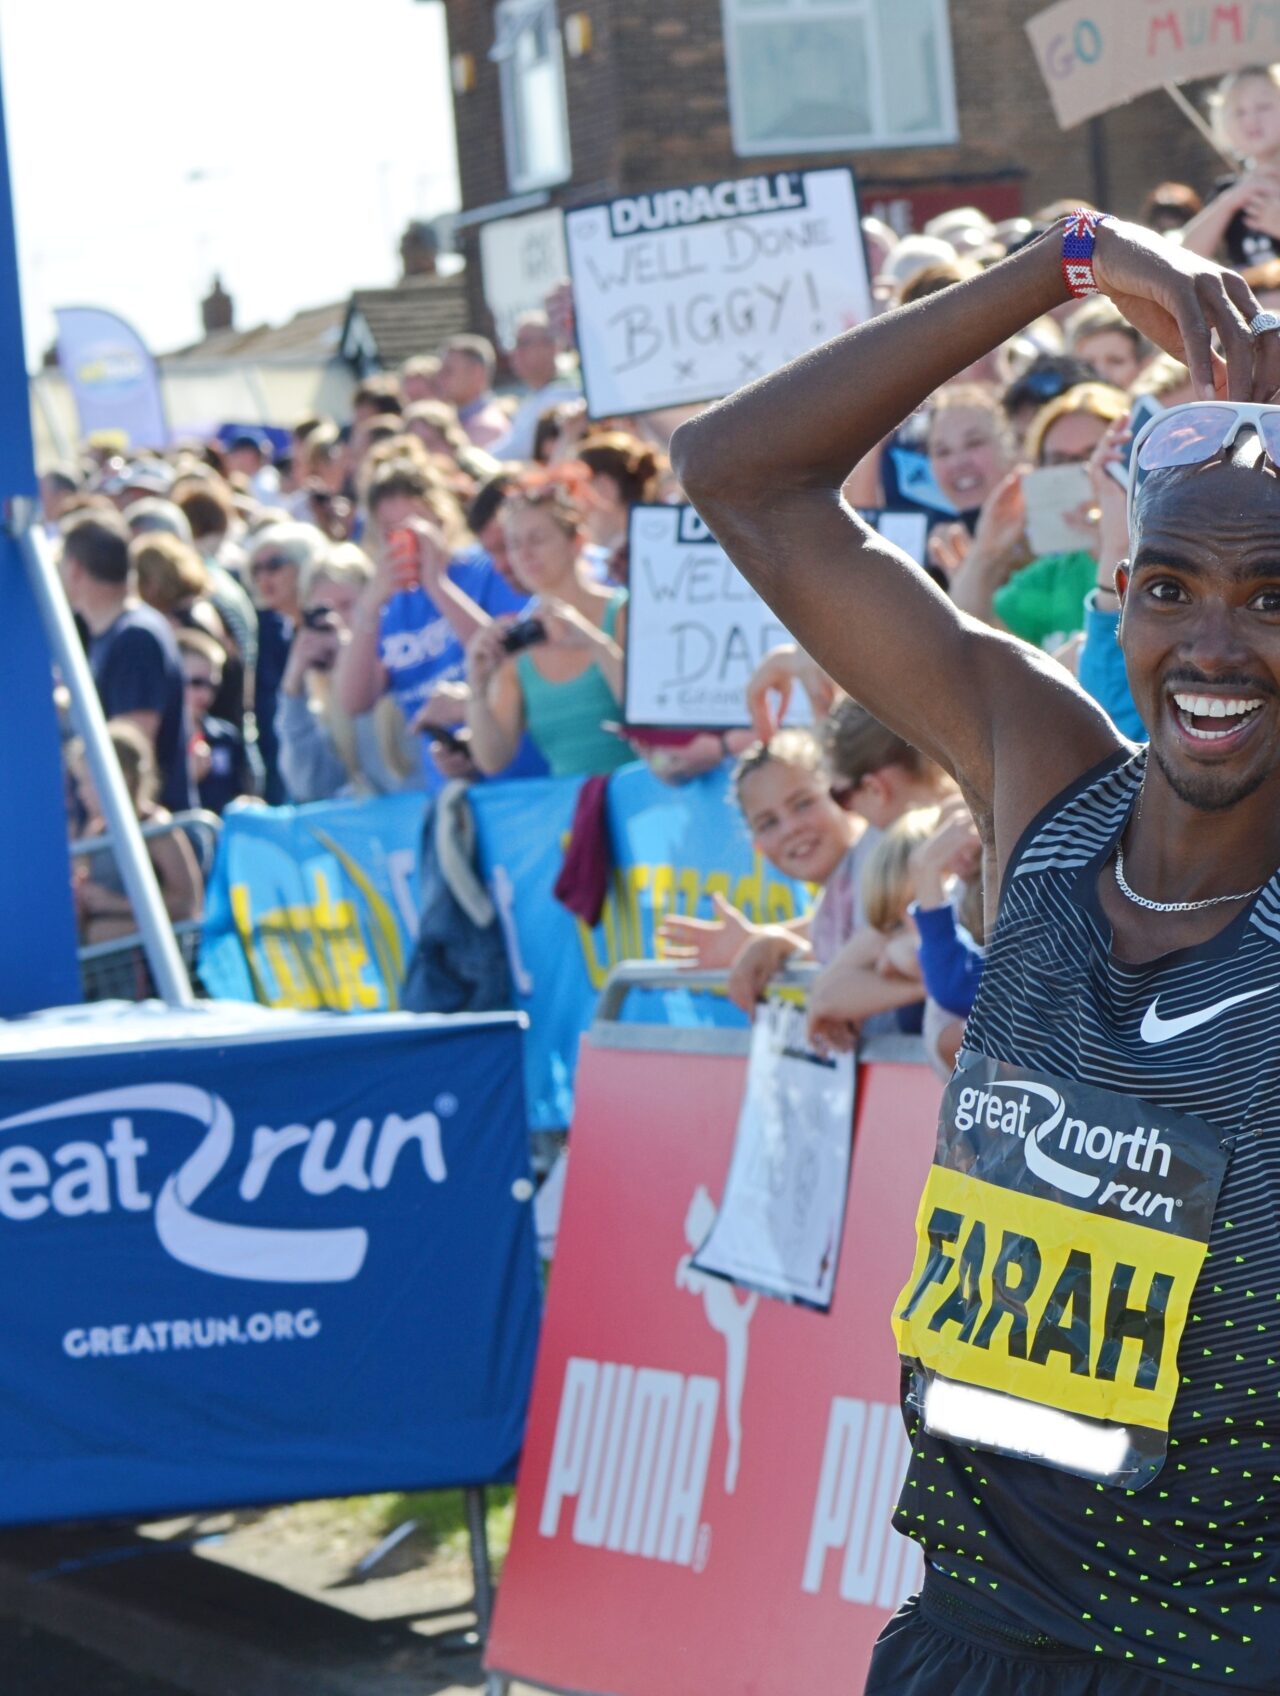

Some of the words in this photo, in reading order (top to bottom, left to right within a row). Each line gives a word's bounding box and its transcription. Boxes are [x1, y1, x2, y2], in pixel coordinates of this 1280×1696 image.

[1046, 19, 1102, 80] GO
[613, 175, 799, 234] DURACELL
[585, 235, 708, 292] WELL
[641, 551, 758, 605] WEL
[239, 1112, 448, 1202] run
[954, 1085, 1031, 1131] great
[1058, 1113, 1173, 1178] north
[1097, 1176, 1176, 1223] run
[899, 1206, 1176, 1392] FARAH
[63, 1309, 321, 1359] GREATRUN.ORG
[539, 1356, 721, 1567] PUMA
